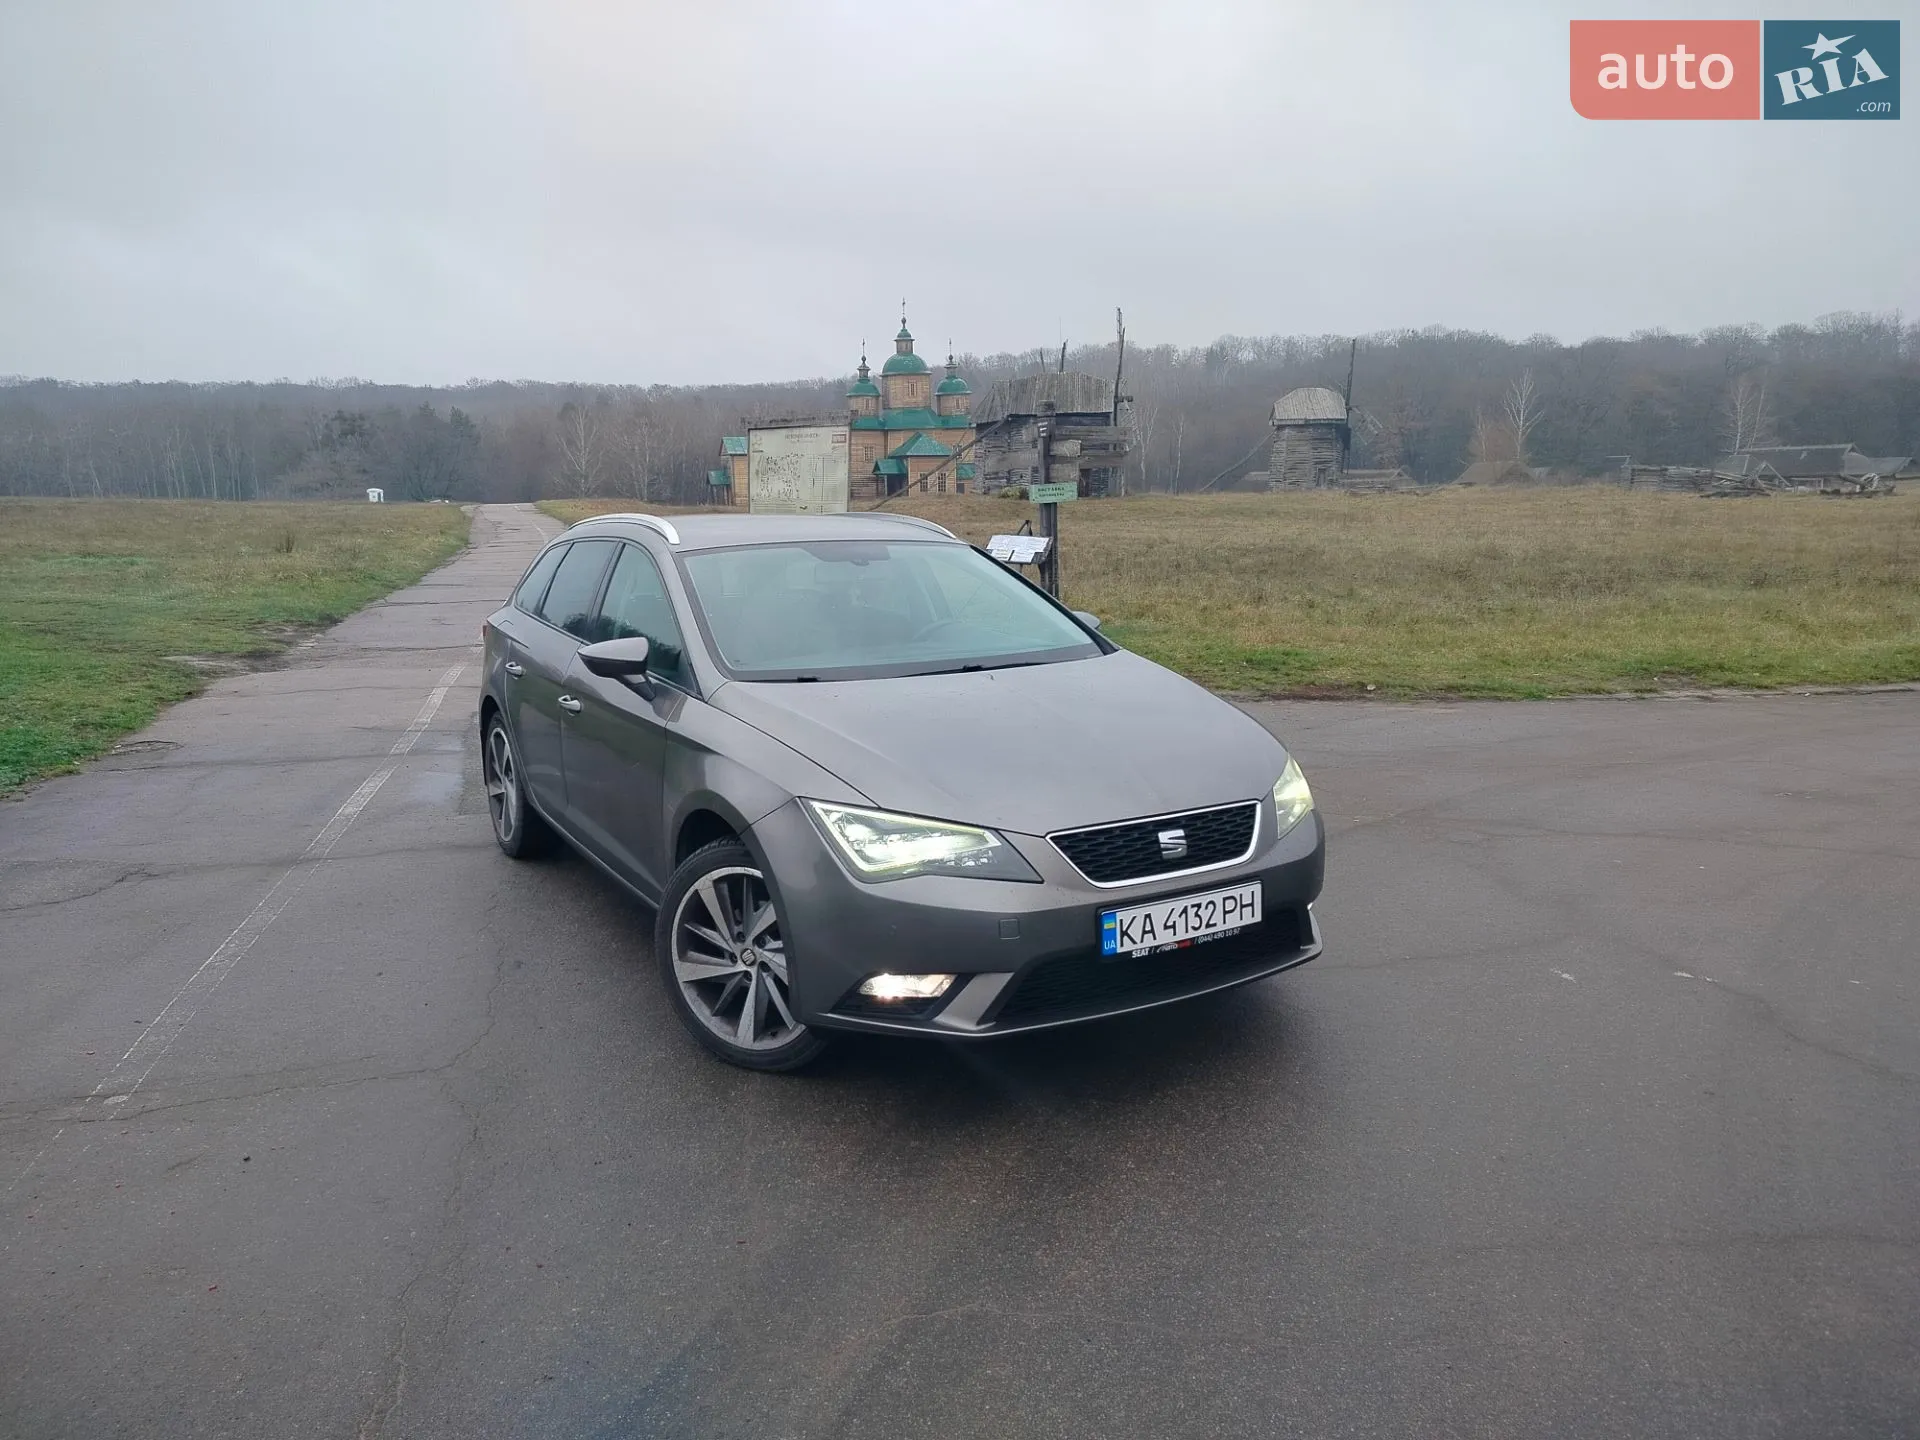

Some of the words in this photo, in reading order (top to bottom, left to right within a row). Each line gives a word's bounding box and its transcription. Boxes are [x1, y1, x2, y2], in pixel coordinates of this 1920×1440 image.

[1119, 912, 1157, 948] KA
[1163, 900, 1217, 936] 4132
[1222, 890, 1255, 925] PH
[1104, 941, 1116, 950] UA
[1132, 948, 1150, 958] SEAT
